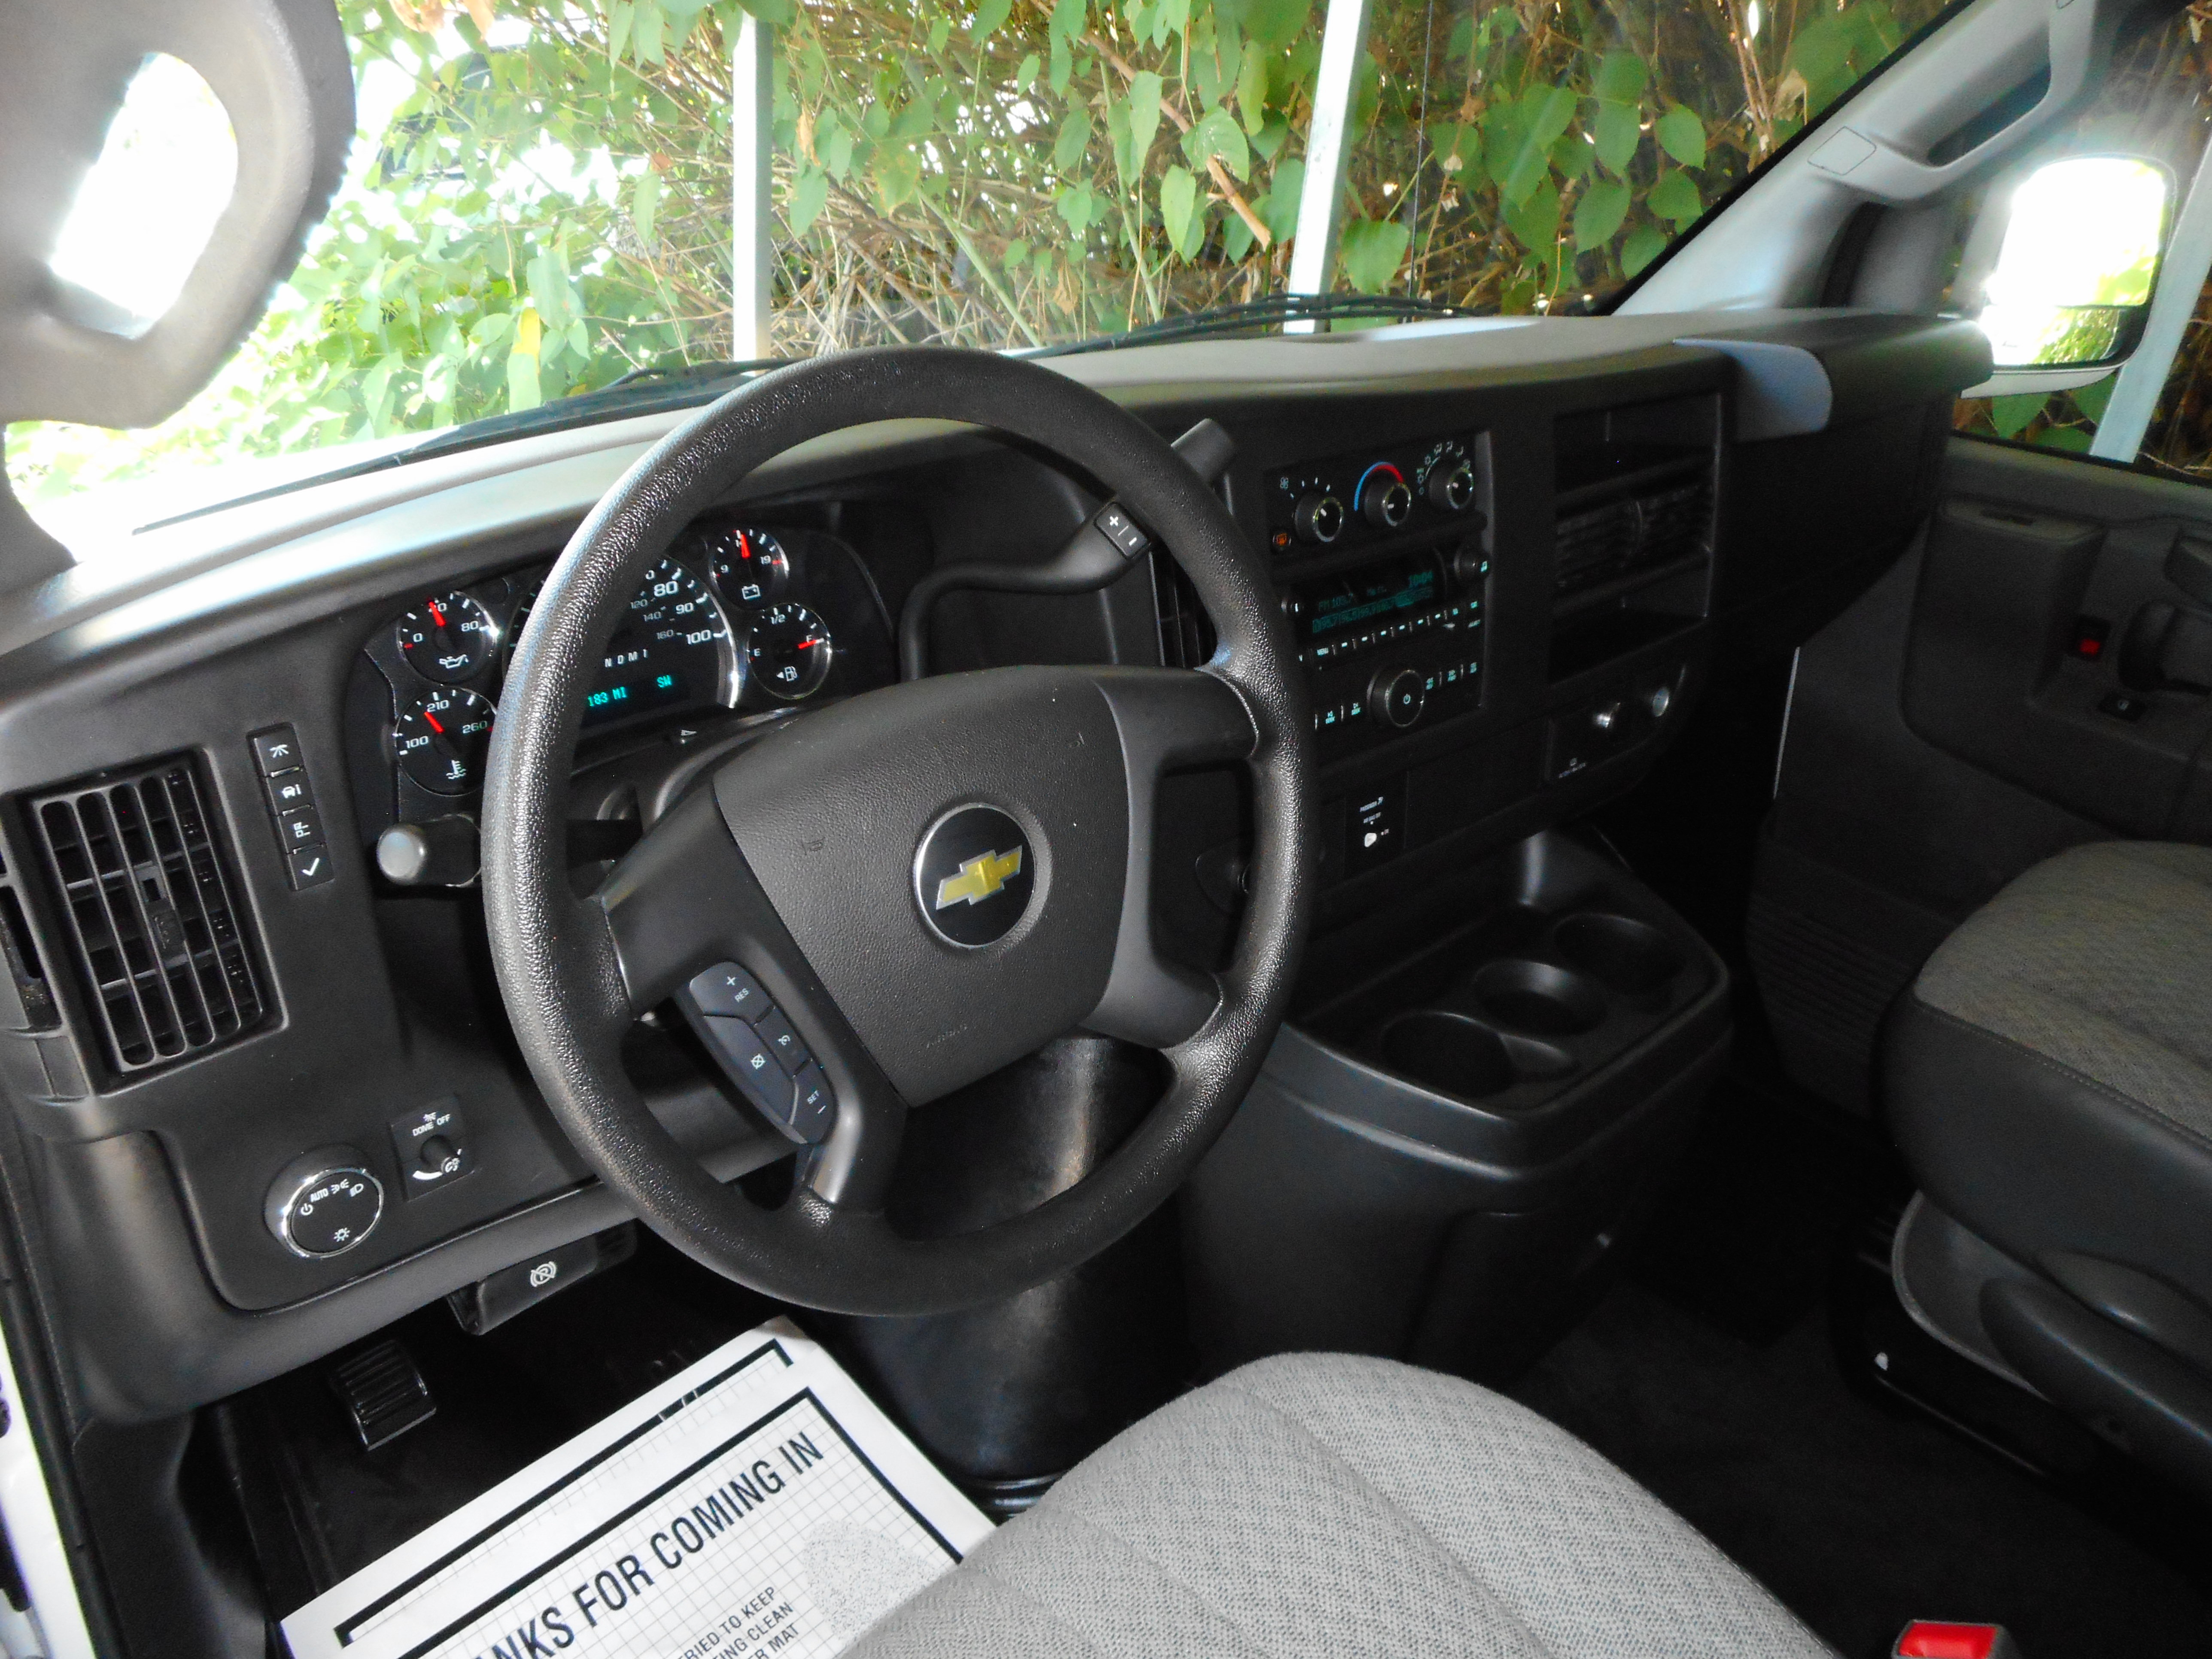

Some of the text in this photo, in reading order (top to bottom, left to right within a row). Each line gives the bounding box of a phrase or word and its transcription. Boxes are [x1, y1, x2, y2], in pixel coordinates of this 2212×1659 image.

[760, 555, 771, 565] 19
[720, 565, 729, 574] 9
[653, 581, 679, 597] 80
[630, 599, 648, 609] 120
[676, 602, 694, 614] 90
[643, 611, 661, 622] 140
[770, 614, 785, 624] 1/2
[461, 621, 479, 632] 80
[413, 633, 423, 642] 0
[656, 629, 674, 640] 160
[686, 629, 711, 644] 100
[754, 648, 761, 656] E
[605, 658, 612, 667] N
[628, 651, 638, 661] M
[657, 675, 672, 688] SW
[613, 687, 627, 699] MI
[427, 699, 450, 712] 210
[462, 720, 488, 734] 260
[405, 735, 428, 748] 100
[735, 988, 749, 1003] RES
[807, 1090, 820, 1104] SET
[412, 1114, 450, 1136] DOME OFF
[310, 1188, 329, 1202] AUTO
[572, 1554, 655, 1628] FOR
[650, 1460, 786, 1570] COMING
[779, 1431, 824, 1474] IN
[719, 1615, 741, 1634] TO
[741, 1586, 775, 1619] KEEP
[747, 1601, 793, 1641] CLEAN
[768, 1623, 799, 1653] MAT
